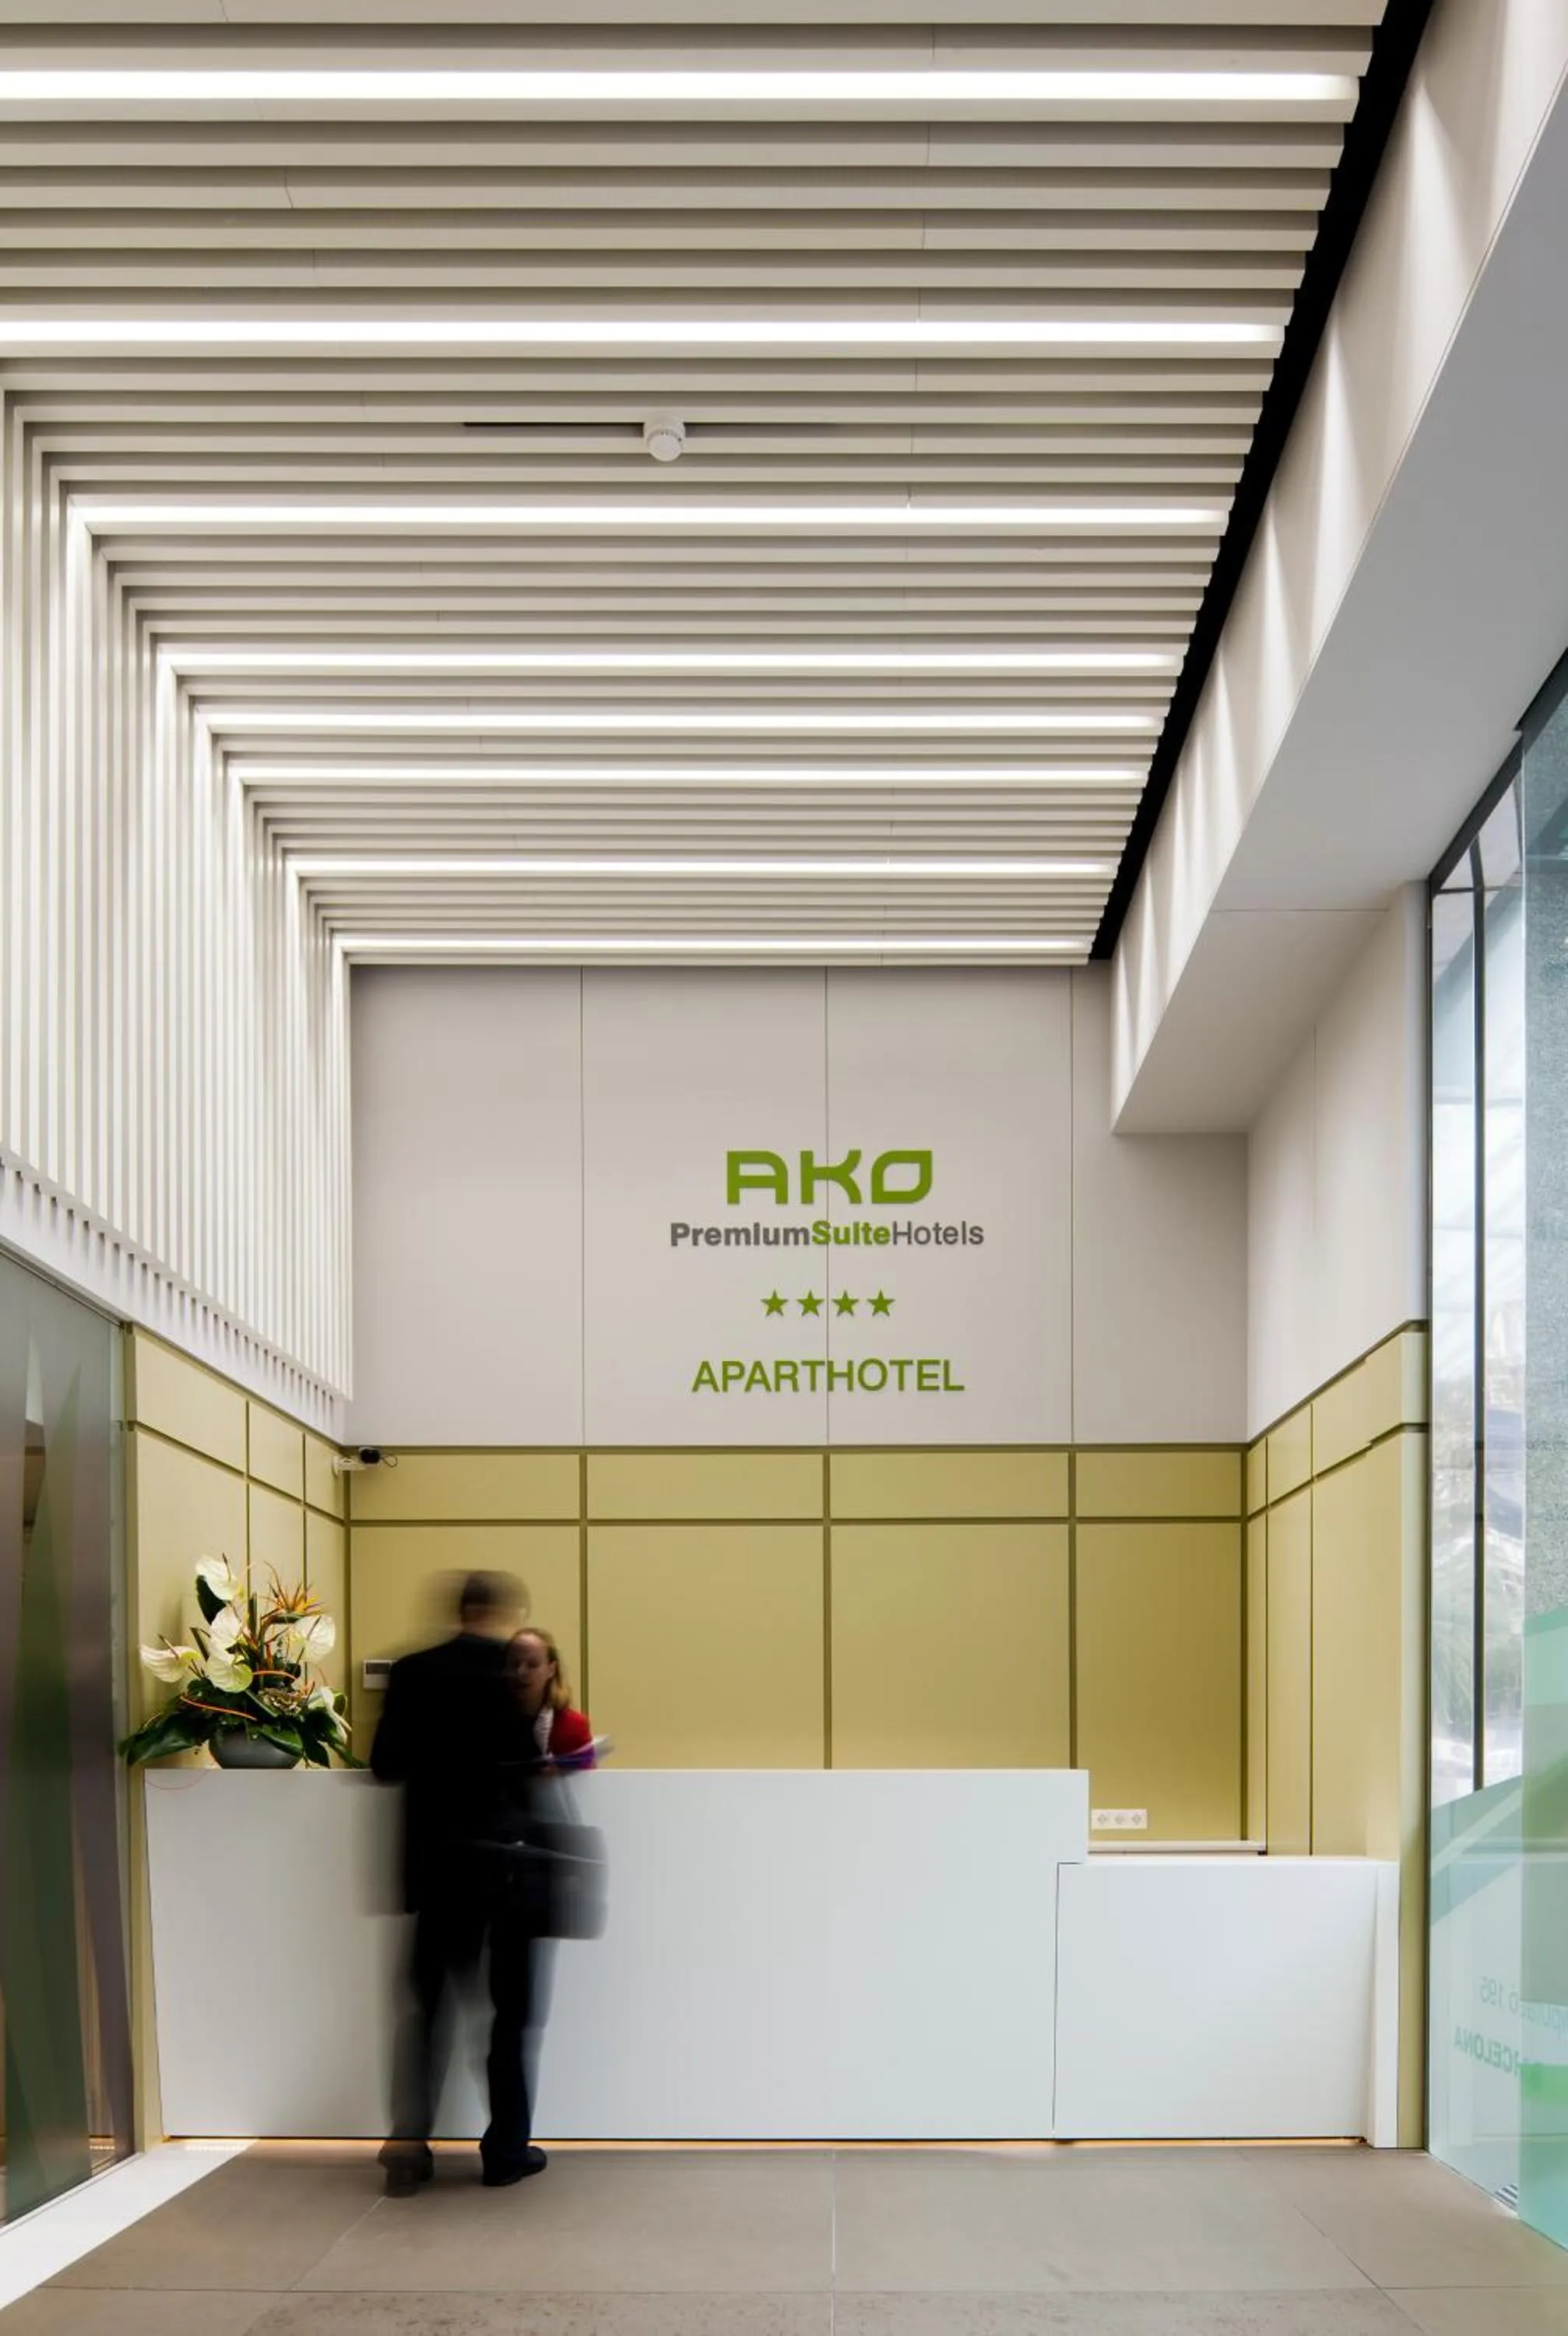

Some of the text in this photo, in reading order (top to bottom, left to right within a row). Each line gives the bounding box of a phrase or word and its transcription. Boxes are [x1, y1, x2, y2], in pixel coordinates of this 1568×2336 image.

[726, 1150, 933, 1205] AKO
[670, 1221, 984, 1246] PremiumSuiteHotels
[691, 1358, 965, 1392] APARTHOTEL
